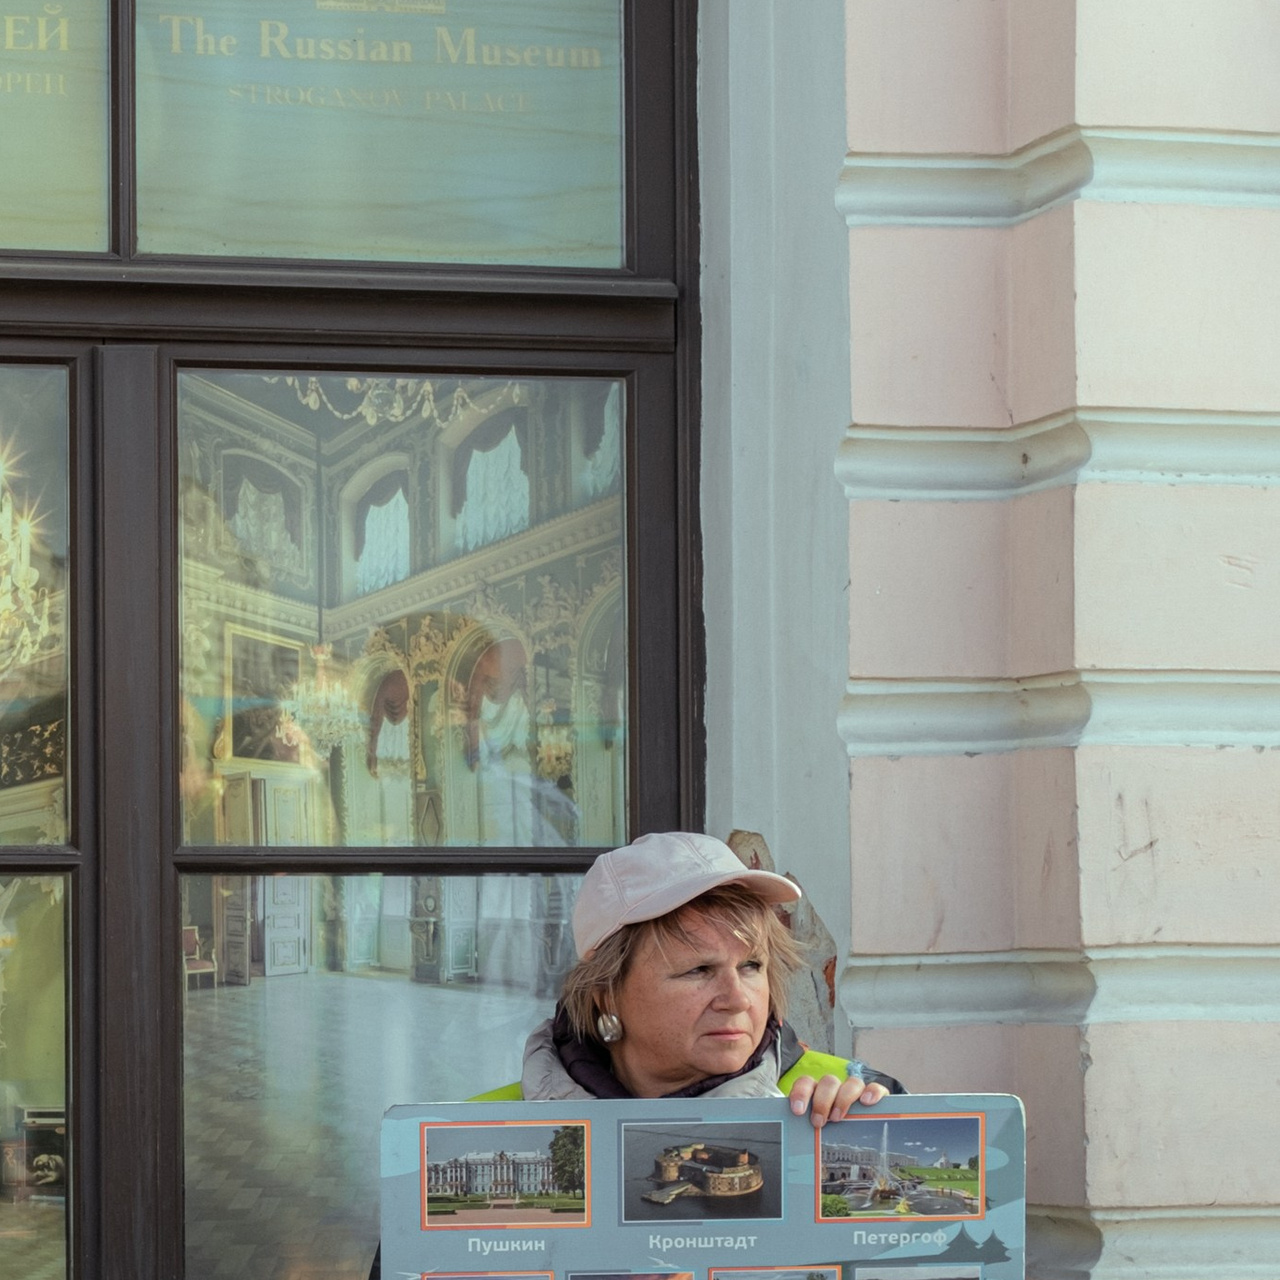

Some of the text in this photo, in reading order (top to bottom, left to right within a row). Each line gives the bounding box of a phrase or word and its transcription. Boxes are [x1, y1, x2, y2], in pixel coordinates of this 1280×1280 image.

[159, 14, 602, 69] The Russian Museum
[468, 1238, 546, 1255] Пушкин
[649, 1234, 758, 1252] Кронштадт
[853, 1228, 948, 1248] Петергоф
